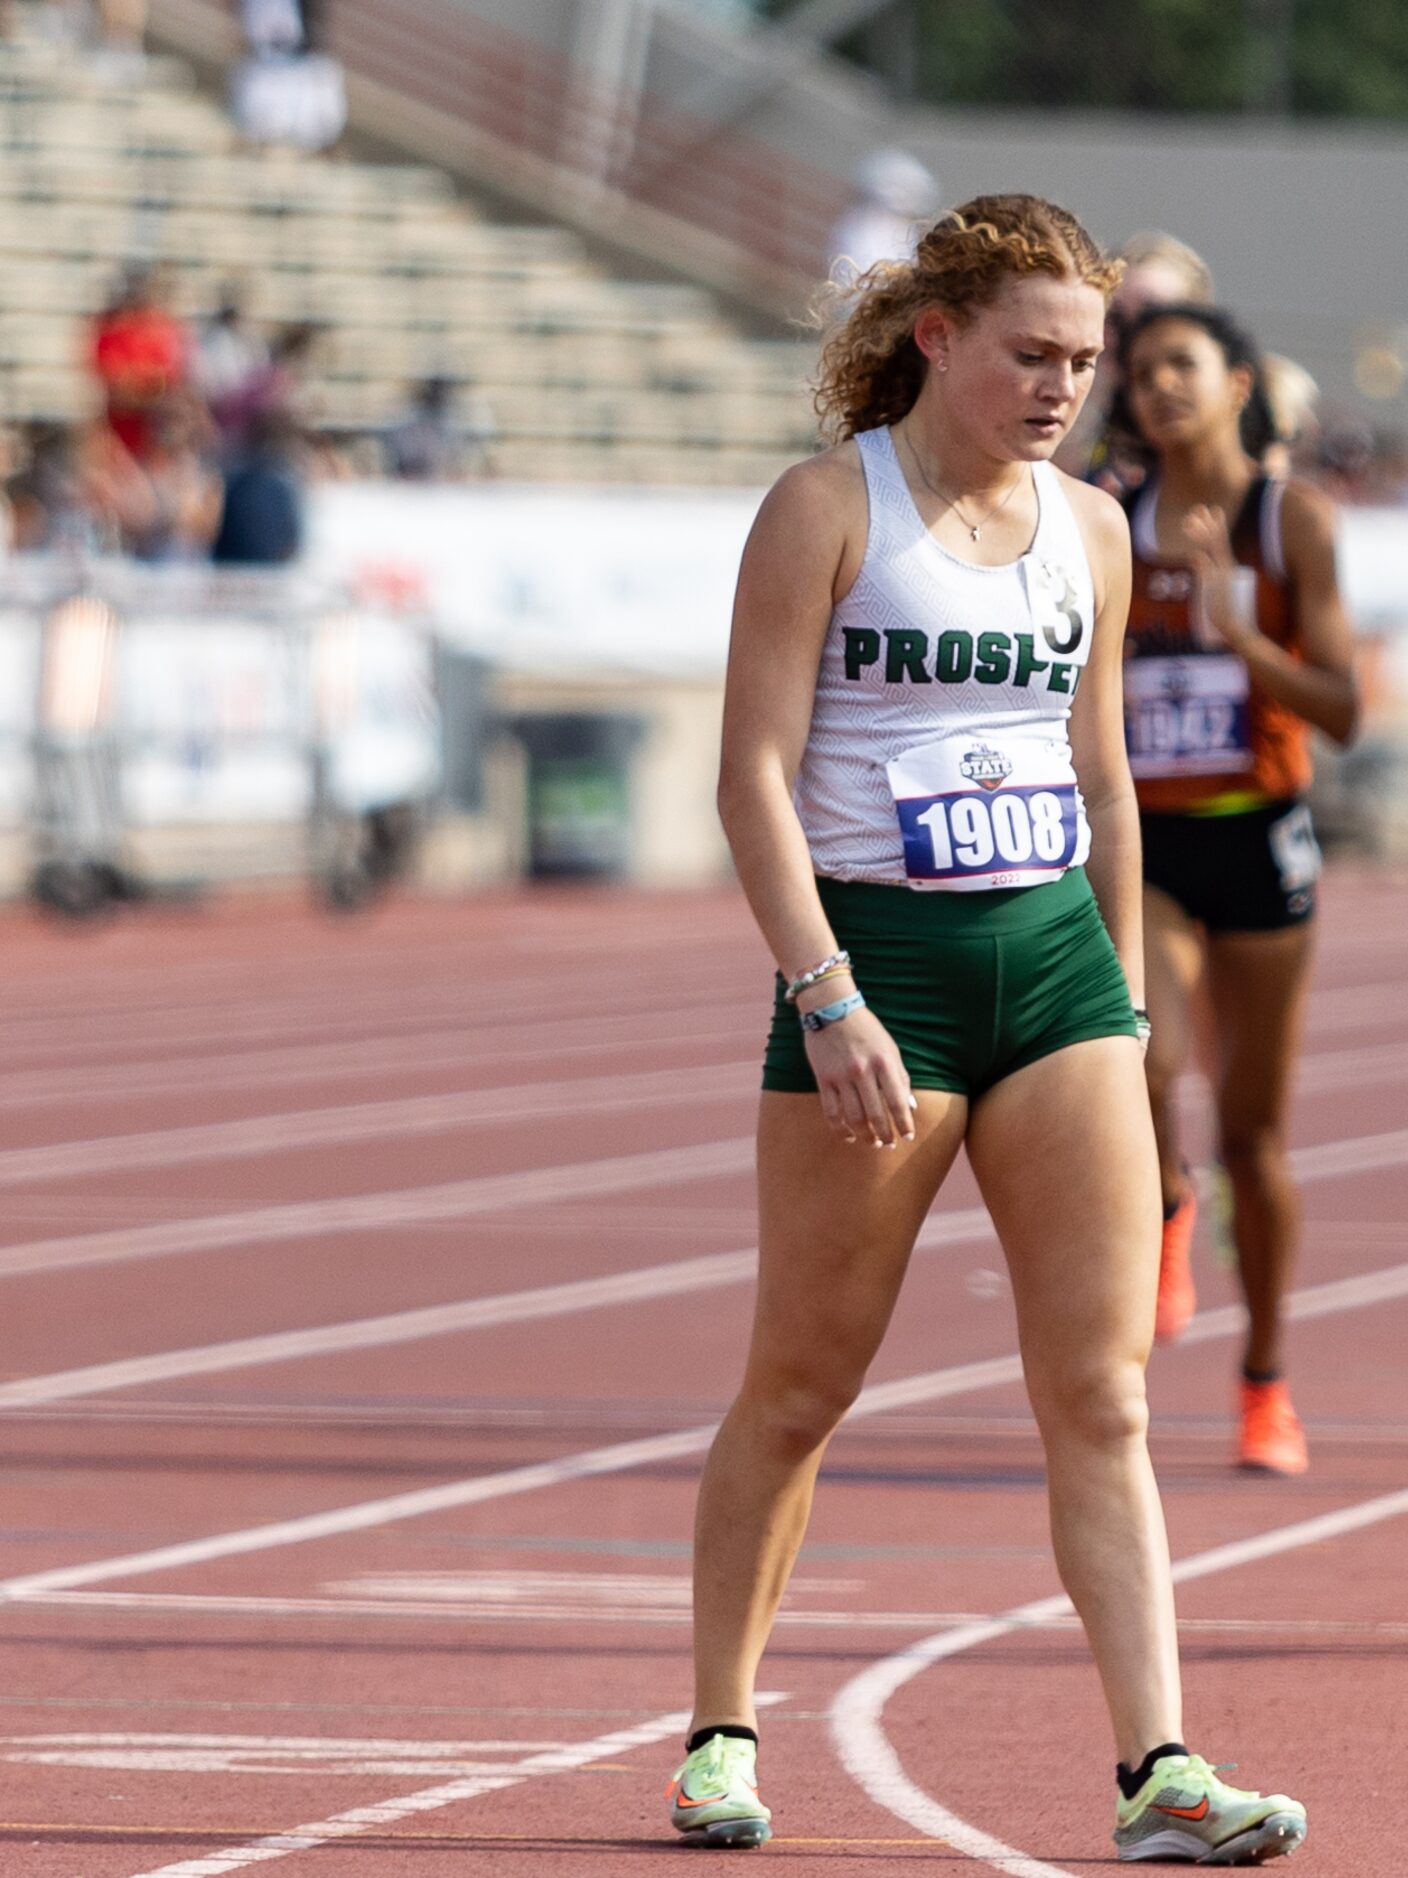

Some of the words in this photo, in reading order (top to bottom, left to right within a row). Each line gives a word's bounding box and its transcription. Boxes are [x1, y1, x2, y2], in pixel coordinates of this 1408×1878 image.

[1041, 566, 1083, 654] 3
[842, 626, 1083, 696] PROSPE
[960, 758, 1013, 777] STATE
[917, 791, 1067, 870] 1908
